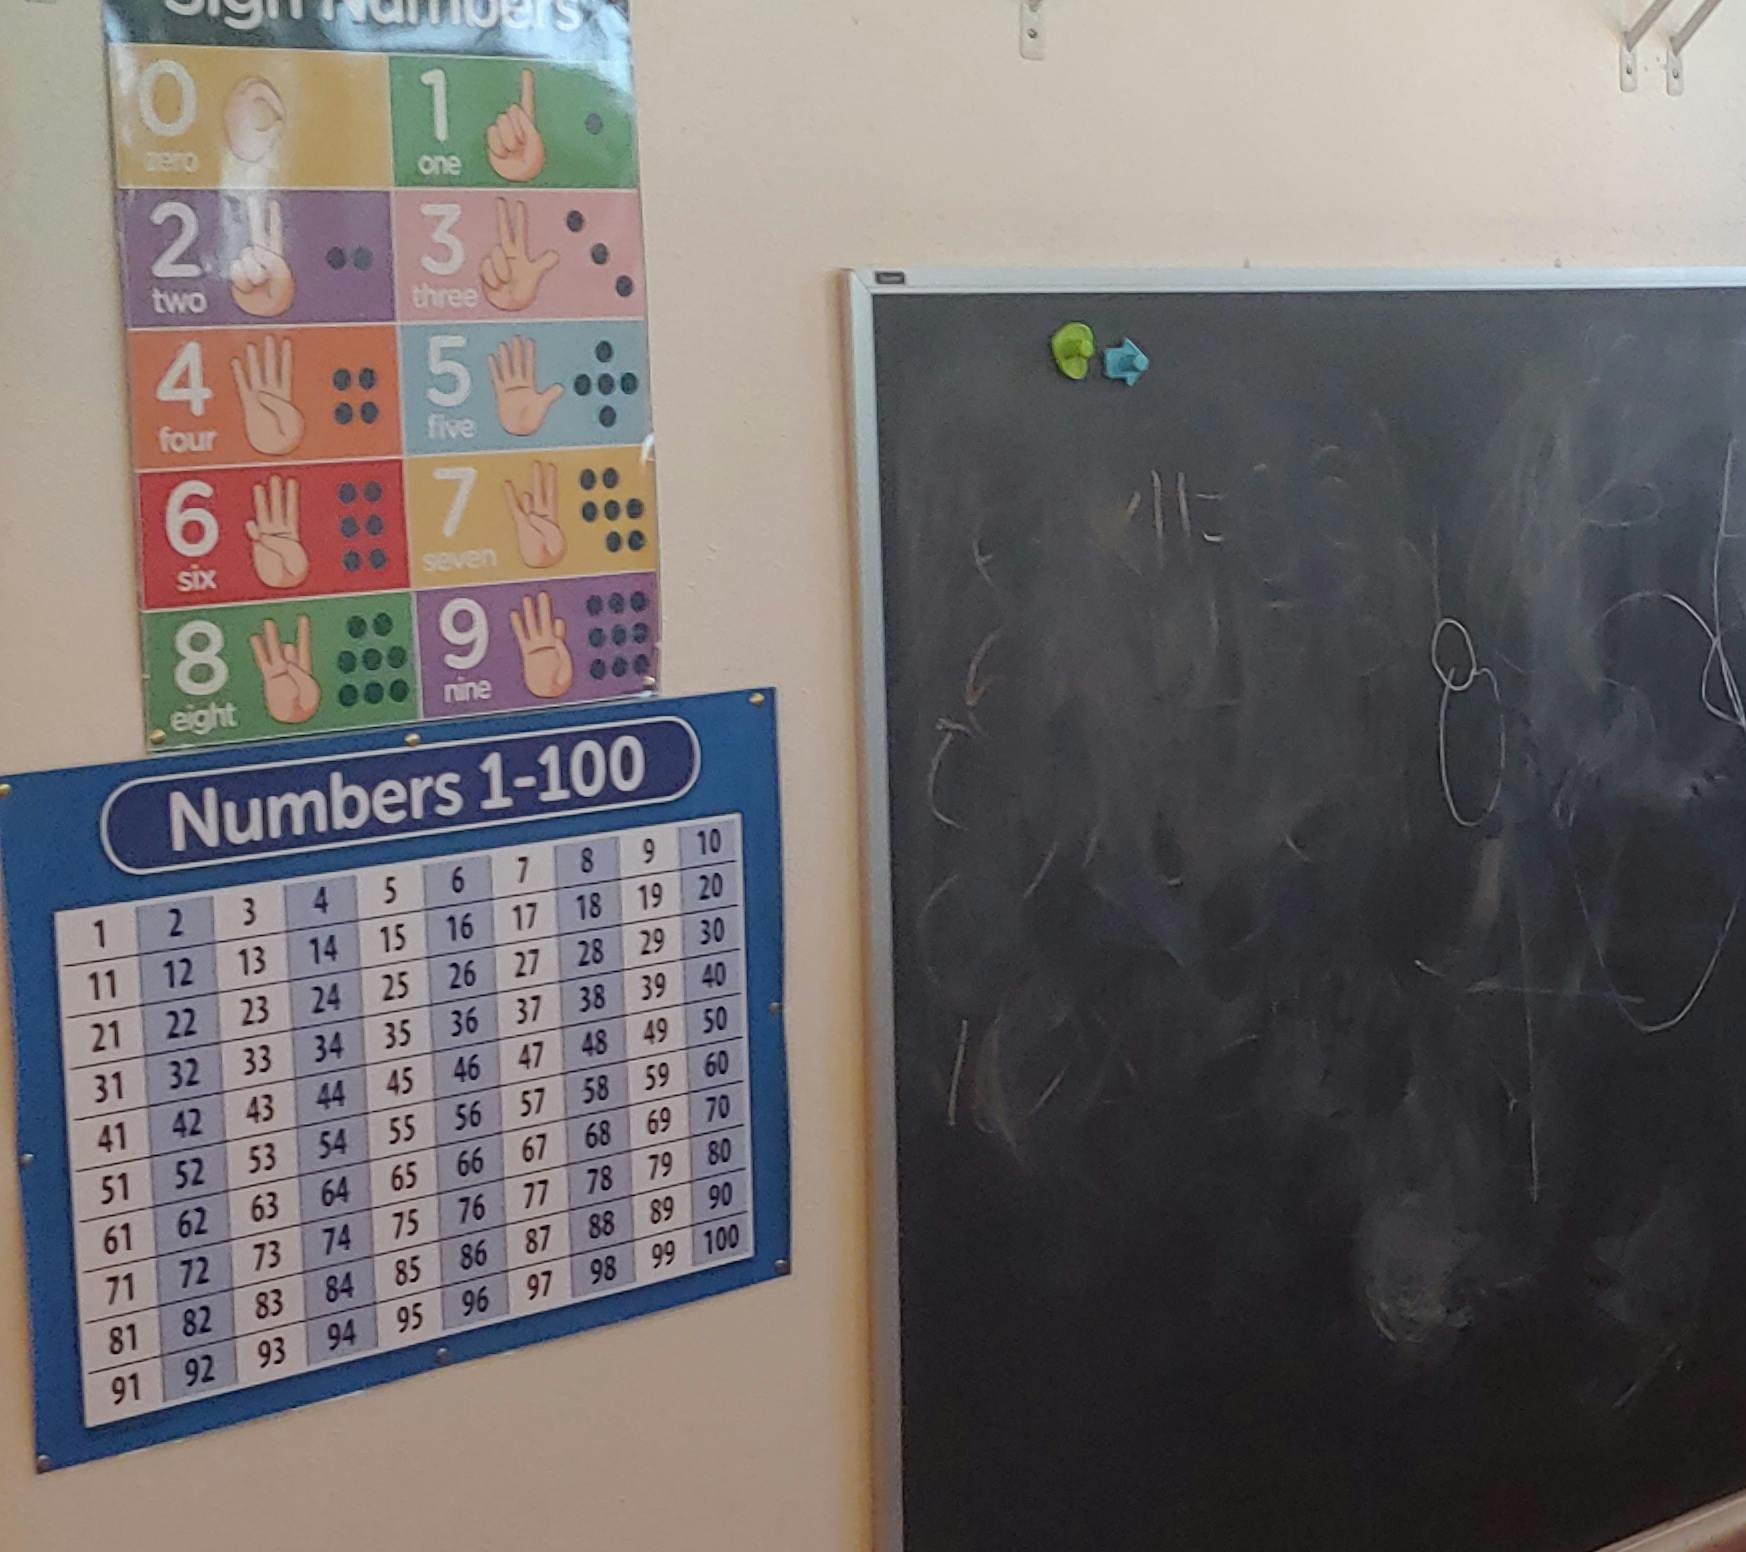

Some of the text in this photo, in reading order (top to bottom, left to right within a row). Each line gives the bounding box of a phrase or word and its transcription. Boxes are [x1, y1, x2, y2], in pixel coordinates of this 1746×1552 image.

[139, 58, 197, 137] 0
[420, 68, 449, 143] 1
[146, 151, 198, 174] zero
[418, 153, 462, 177] one
[150, 201, 203, 278] 2
[420, 203, 465, 276] 3
[152, 287, 208, 315] two
[411, 283, 480, 309] three
[155, 341, 213, 417] 4
[427, 335, 472, 407] 5
[159, 426, 217, 454] four
[428, 413, 476, 439] five
[165, 479, 220, 558] 6
[433, 467, 477, 538] 7
[176, 563, 217, 593] six
[422, 547, 497, 573] seven
[173, 619, 229, 696] 8
[439, 598, 489, 670] 9
[170, 701, 238, 735] eight
[443, 677, 493, 703] nine
[169, 735, 646, 852] Numbers 1-100
[92, 827, 722, 949] 1 2 3 4 5 6 7 8 9 10
[87, 871, 724, 1001] 11 12 13 14 15 16 17 18 19 20
[89, 916, 726, 1053] 21 22 23 24 25 26 27 28 29 30
[93, 960, 727, 1104] 31 32 33 34 35 36 37 38 39 40
[96, 1005, 729, 1154] 41 42 43 44 45 46 47 48 49 50
[100, 1049, 730, 1206] 51 52 53 54 55 56 57 58 59 60
[103, 1093, 731, 1255] 61 62 63 64 65 66 67 68 69 70
[105, 1137, 733, 1307] 71 72 73 74 75 76 77 78 79 80
[108, 1181, 733, 1356] 81 82 83 84 85 86 87 88 89 90
[110, 1223, 742, 1406] 91 92 93 94 95 96 97 98 99 100
